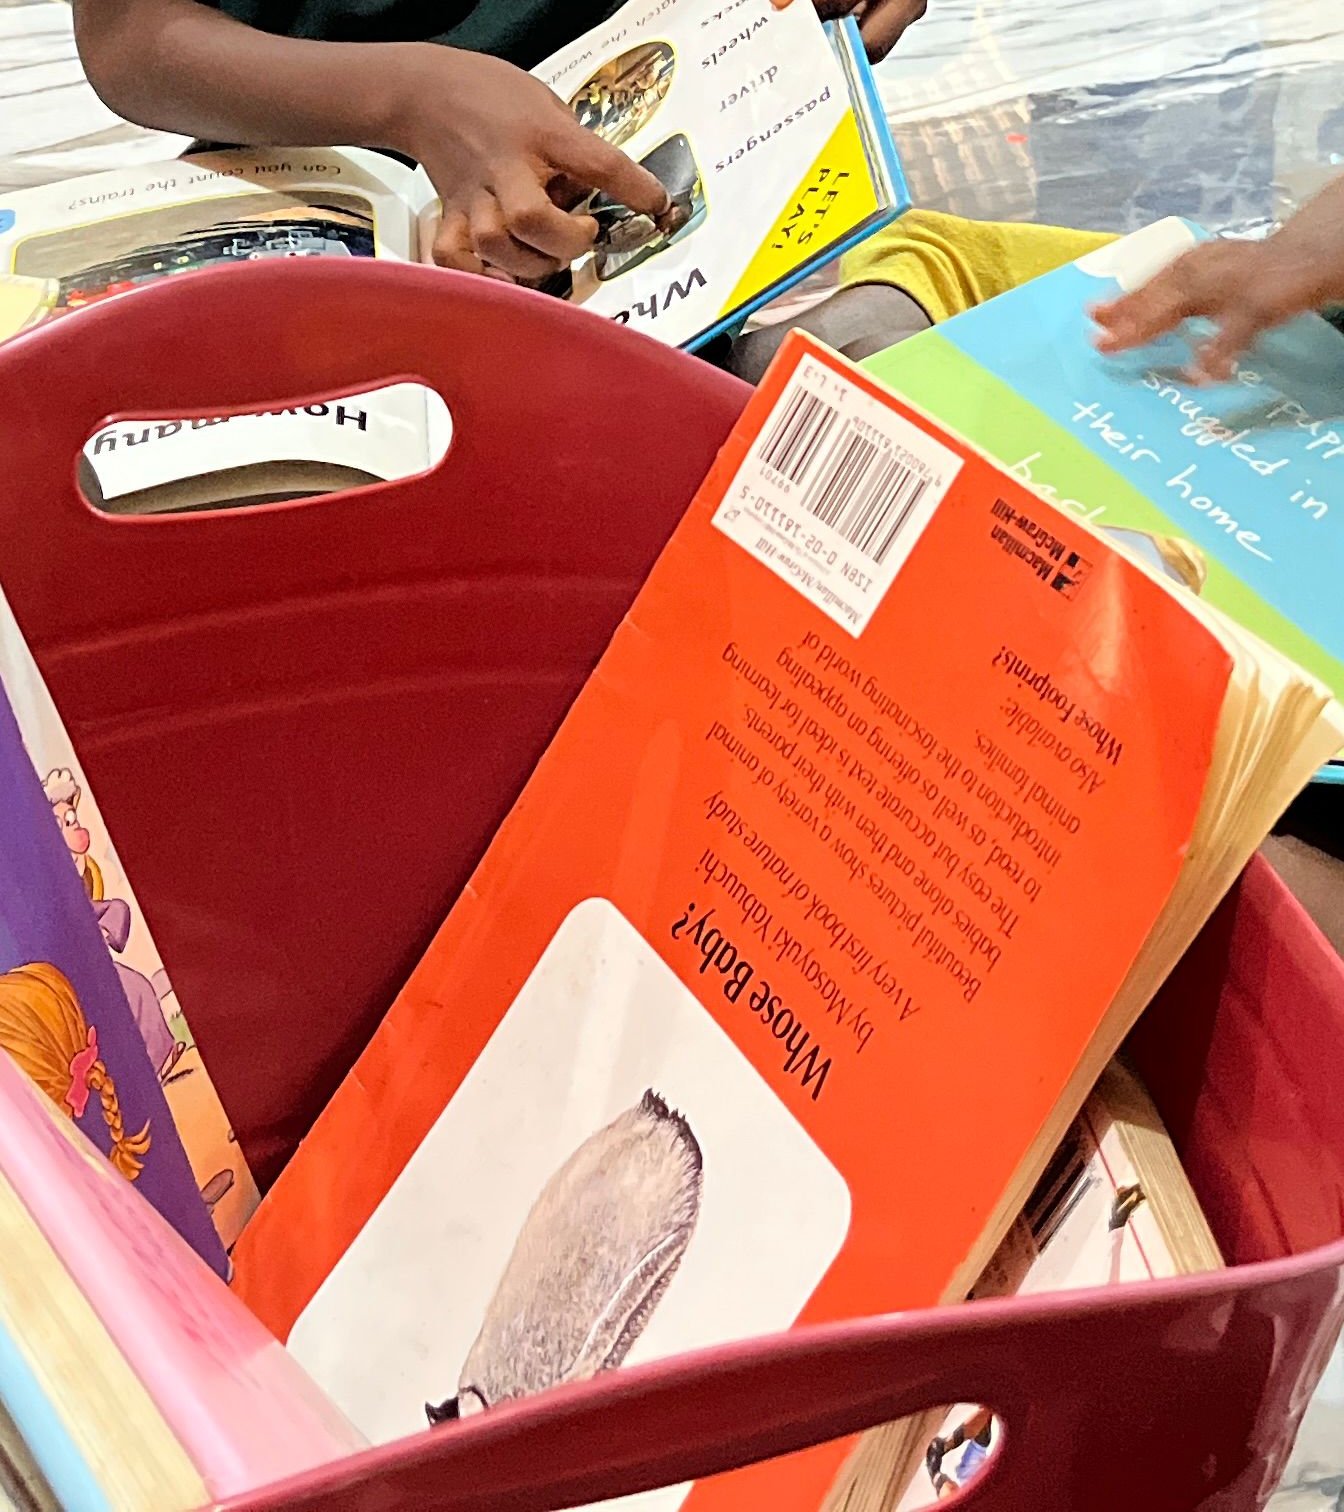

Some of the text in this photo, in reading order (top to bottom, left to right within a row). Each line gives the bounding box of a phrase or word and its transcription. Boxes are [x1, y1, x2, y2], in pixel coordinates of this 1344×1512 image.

[600, 28, 628, 50] the
[701, 15, 769, 70] wheels
[714, 85, 832, 173] passengers
[719, 64, 779, 113] driver
[67, 186, 136, 212] trains?
[145, 177, 177, 193] the
[255, 161, 293, 176] you
[990, 498, 1067, 561] McGraw-Hill
[1071, 400, 1274, 563] their home
[1290, 478, 1329, 520] in
[840, 561, 873, 593] ISBN
[990, 524, 1054, 581] Macmillan
[796, 629, 1061, 873] introduction to the fascinating world of
[991, 645, 1123, 766] Whose Footprints?
[999, 696, 1106, 794] Also available:
[721, 641, 1019, 940] The easy but accurate text is ideal for learning
[775, 646, 1042, 904] to read, as well as offering an appealing
[974, 728, 1081, 834] animal families.
[704, 720, 981, 1003] Beautiful pictures show a variety of animal
[744, 703, 1002, 973] babies alone and then with their parents.
[694, 848, 874, 1054] by Masayuki Yabuuchi
[702, 789, 920, 1021] A very first book of nature study
[670, 902, 831, 1100] Whose Baby?
